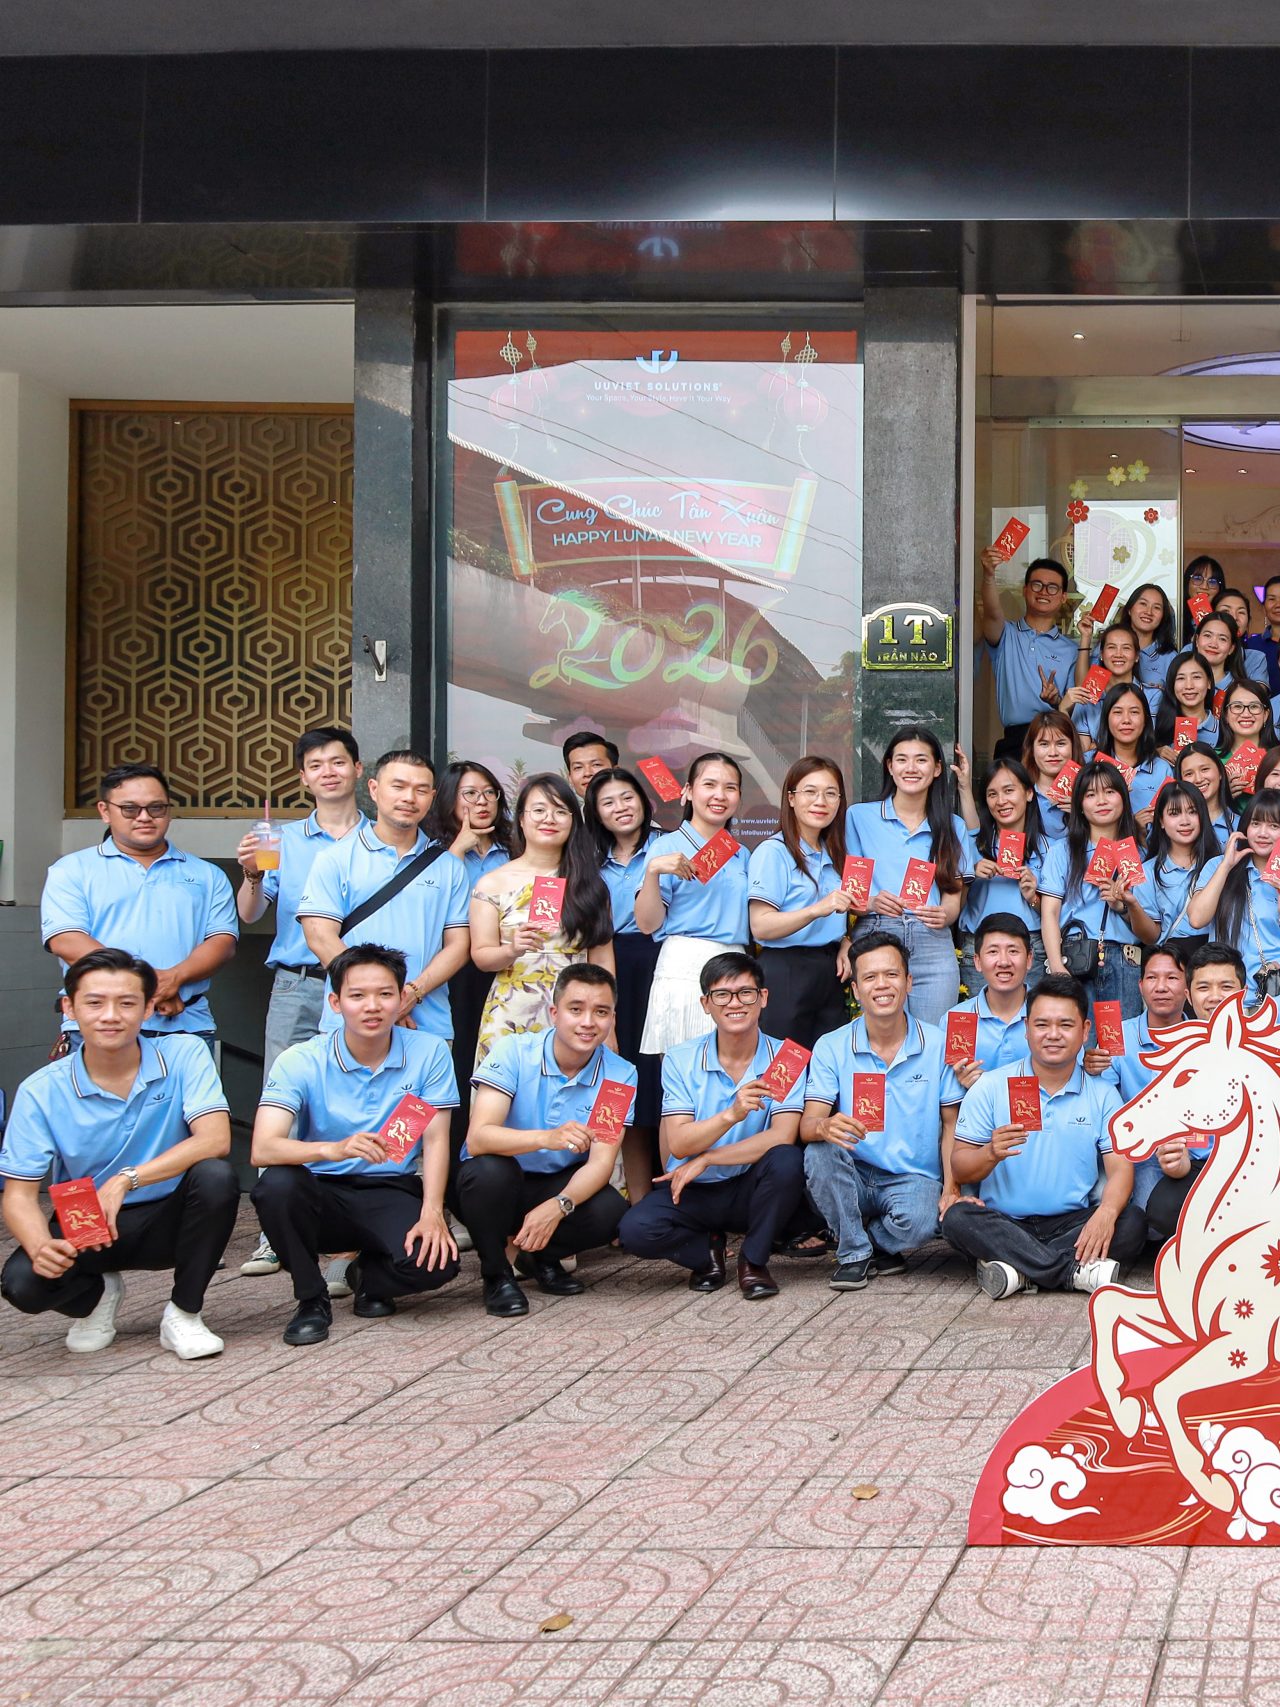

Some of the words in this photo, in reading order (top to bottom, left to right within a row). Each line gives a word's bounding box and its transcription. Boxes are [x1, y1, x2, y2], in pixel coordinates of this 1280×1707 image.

[594, 382, 641, 391] UUVIET
[647, 382, 720, 391] SOLUTIONS
[536, 499, 598, 525] Cung
[603, 494, 662, 521] Chúc
[669, 490, 712, 519] Tân
[718, 499, 780, 527] Xuân
[553, 530, 611, 546] HAPPY
[614, 530, 670, 543] LUNAR
[674, 530, 714, 545] NEW
[716, 532, 762, 548] YEAR
[529, 590, 785, 689] 2026
[911, 650, 938, 661] NÃO
